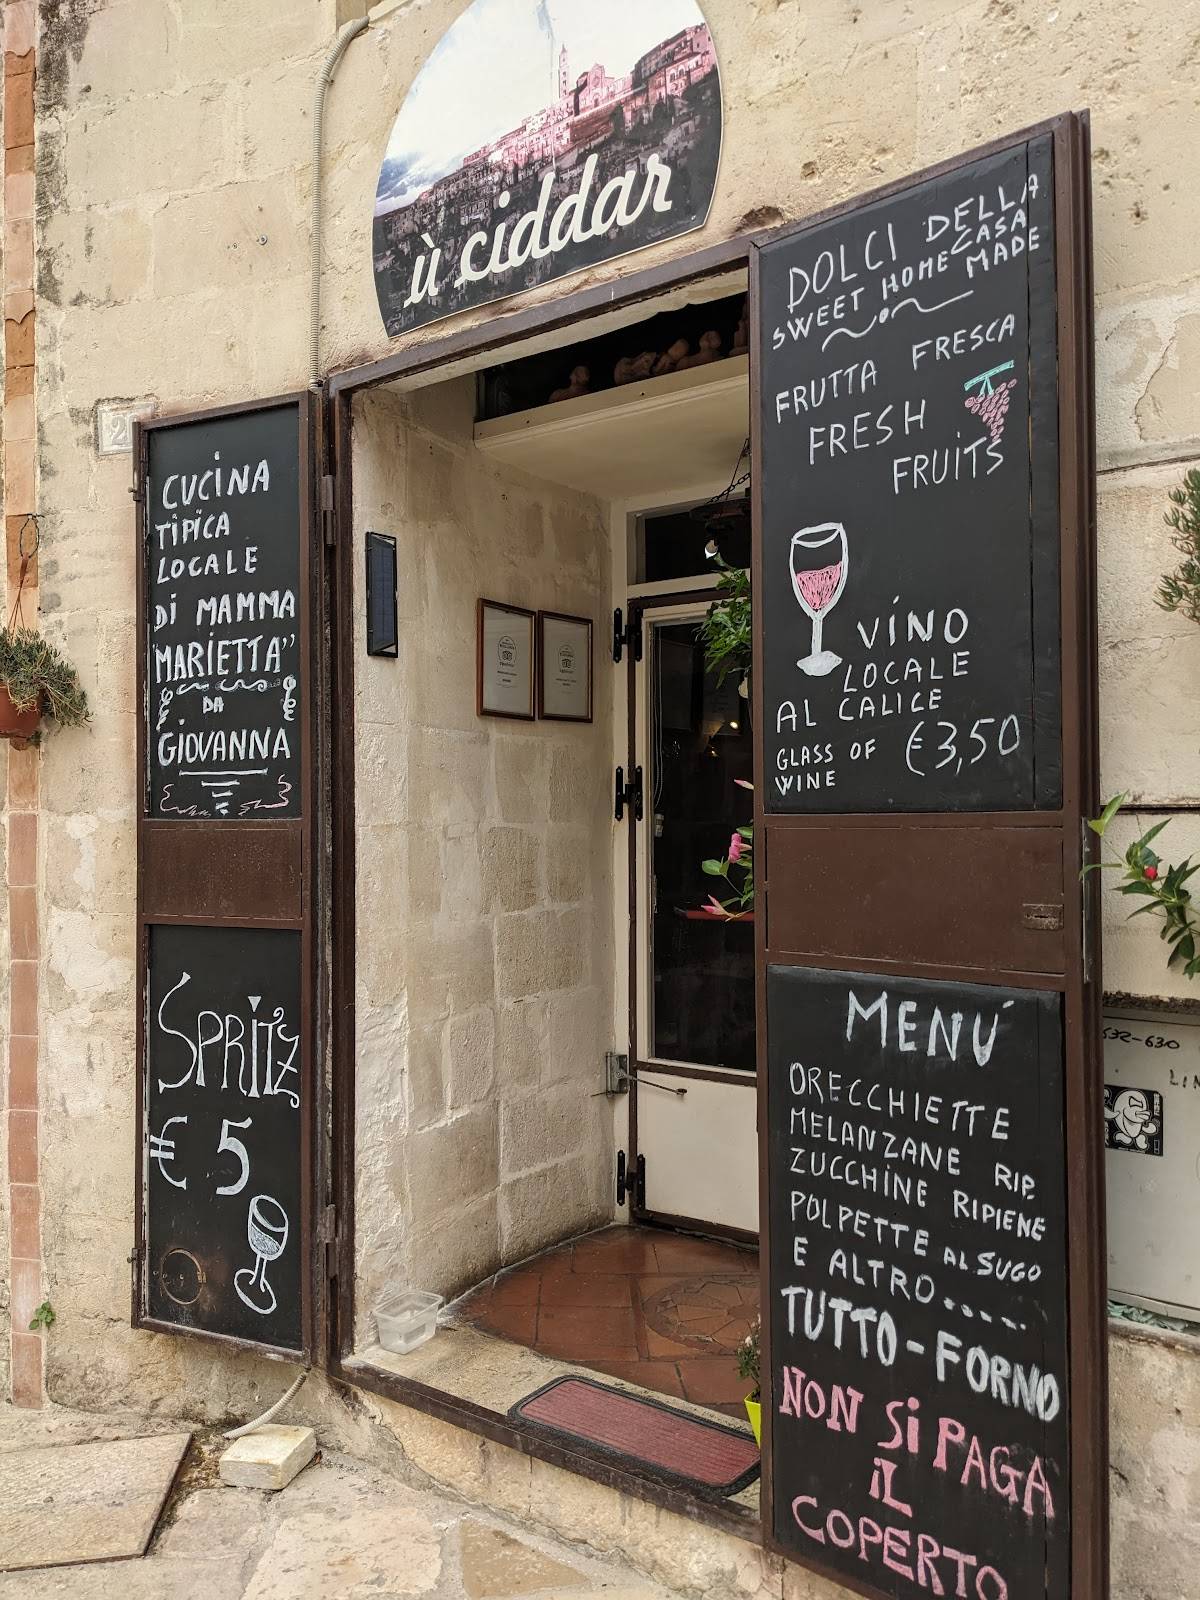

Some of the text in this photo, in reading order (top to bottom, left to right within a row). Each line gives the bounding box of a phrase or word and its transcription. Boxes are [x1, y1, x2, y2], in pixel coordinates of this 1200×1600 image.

[453, 153, 673, 289] ciddar
[787, 173, 1039, 313] DOLCI DELLA
[951, 208, 1027, 255] CASA
[773, 226, 1040, 350] SWEET HOME MADE
[776, 313, 1015, 424] FRUTTA FRESCA
[809, 399, 926, 465] FRESH
[893, 431, 1004, 494] FRUITS
[157, 546, 258, 584] LOCALE
[196, 589, 296, 626] MAMMA
[202, 696, 225, 714] DA
[843, 651, 970, 693] LOCALE
[157, 718, 291, 767] GIOVANNA
[776, 689, 942, 733] AL CALICE
[776, 714, 1020, 776] GLASS OF €3,50
[775, 770, 836, 796] WINE
[789, 1062, 1010, 1140] ORECCHIETTE
[216, 1117, 252, 1195] 5
[790, 1107, 960, 1175] MELANZANE
[790, 1147, 1046, 1241] ZUCCHINE RIPIENE
[791, 1190, 1042, 1282] POLPETTE AL SUGO
[793, 1236, 809, 1266] E
[779, 1365, 864, 1433] NON
[933, 1416, 1055, 1519] PAGA
[791, 1495, 1008, 1600] COPERTO
